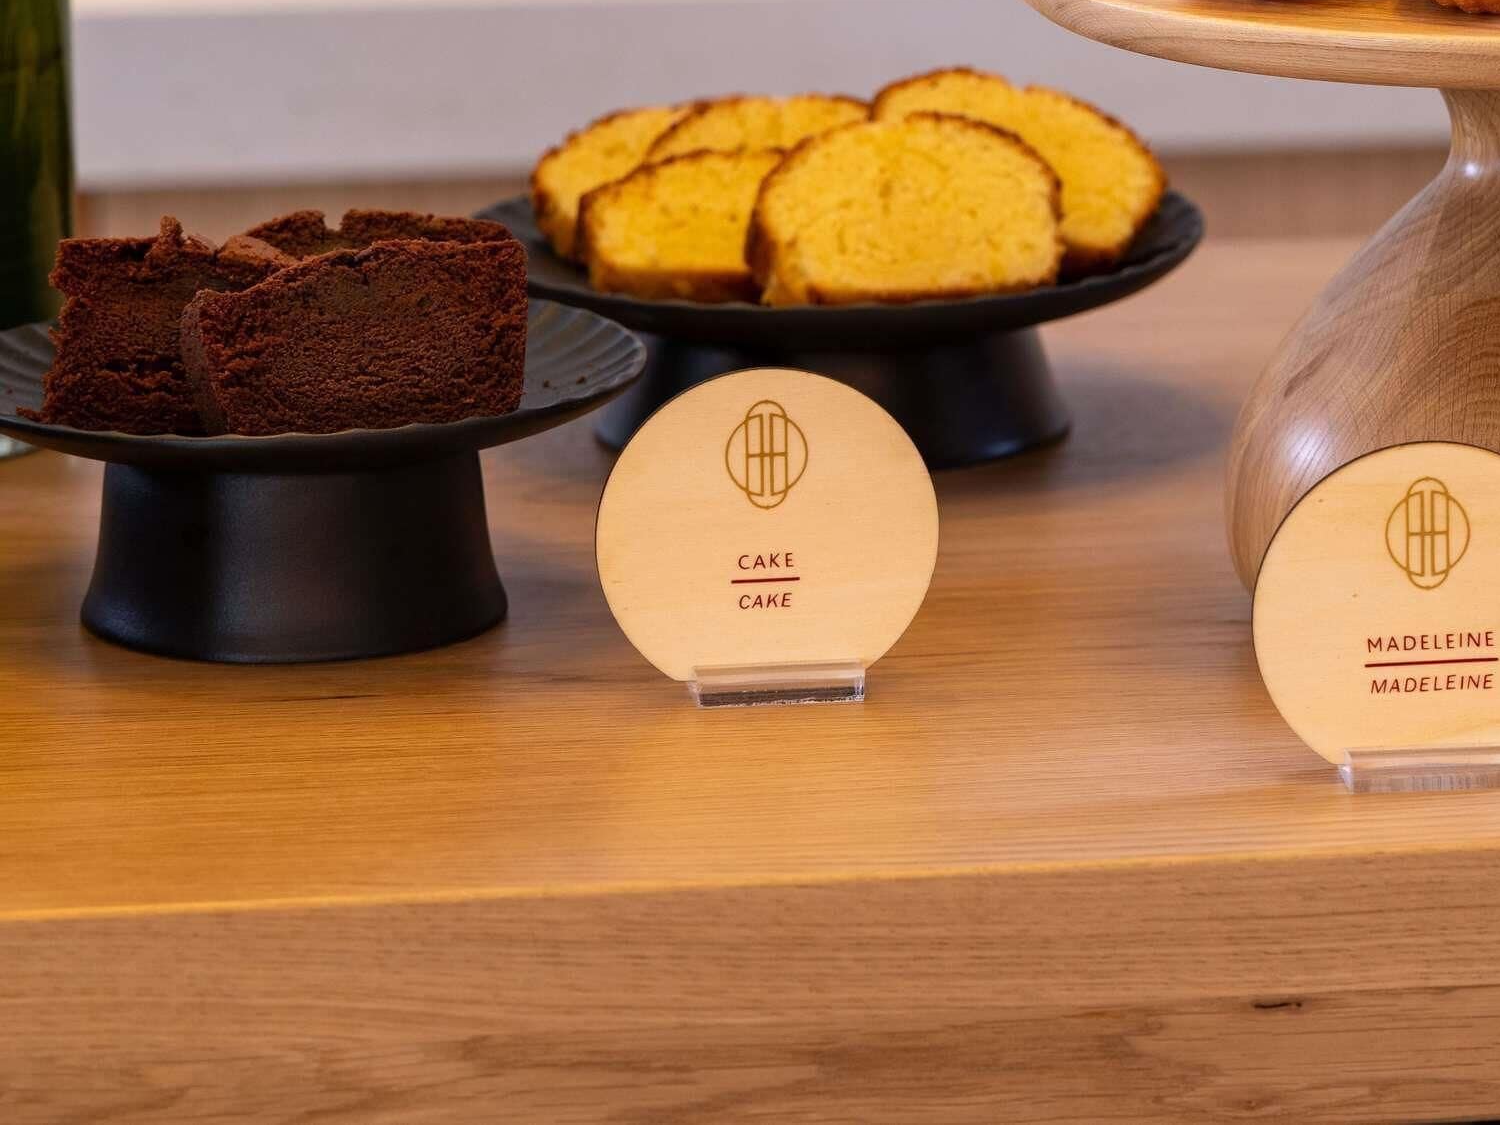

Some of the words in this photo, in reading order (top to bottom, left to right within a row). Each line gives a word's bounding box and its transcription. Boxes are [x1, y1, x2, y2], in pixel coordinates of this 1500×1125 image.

[738, 552, 794, 570] CAKE
[738, 592, 793, 610] CAKE
[1366, 630, 1496, 654] MADELEINE
[1369, 672, 1495, 695] MADELEINE
